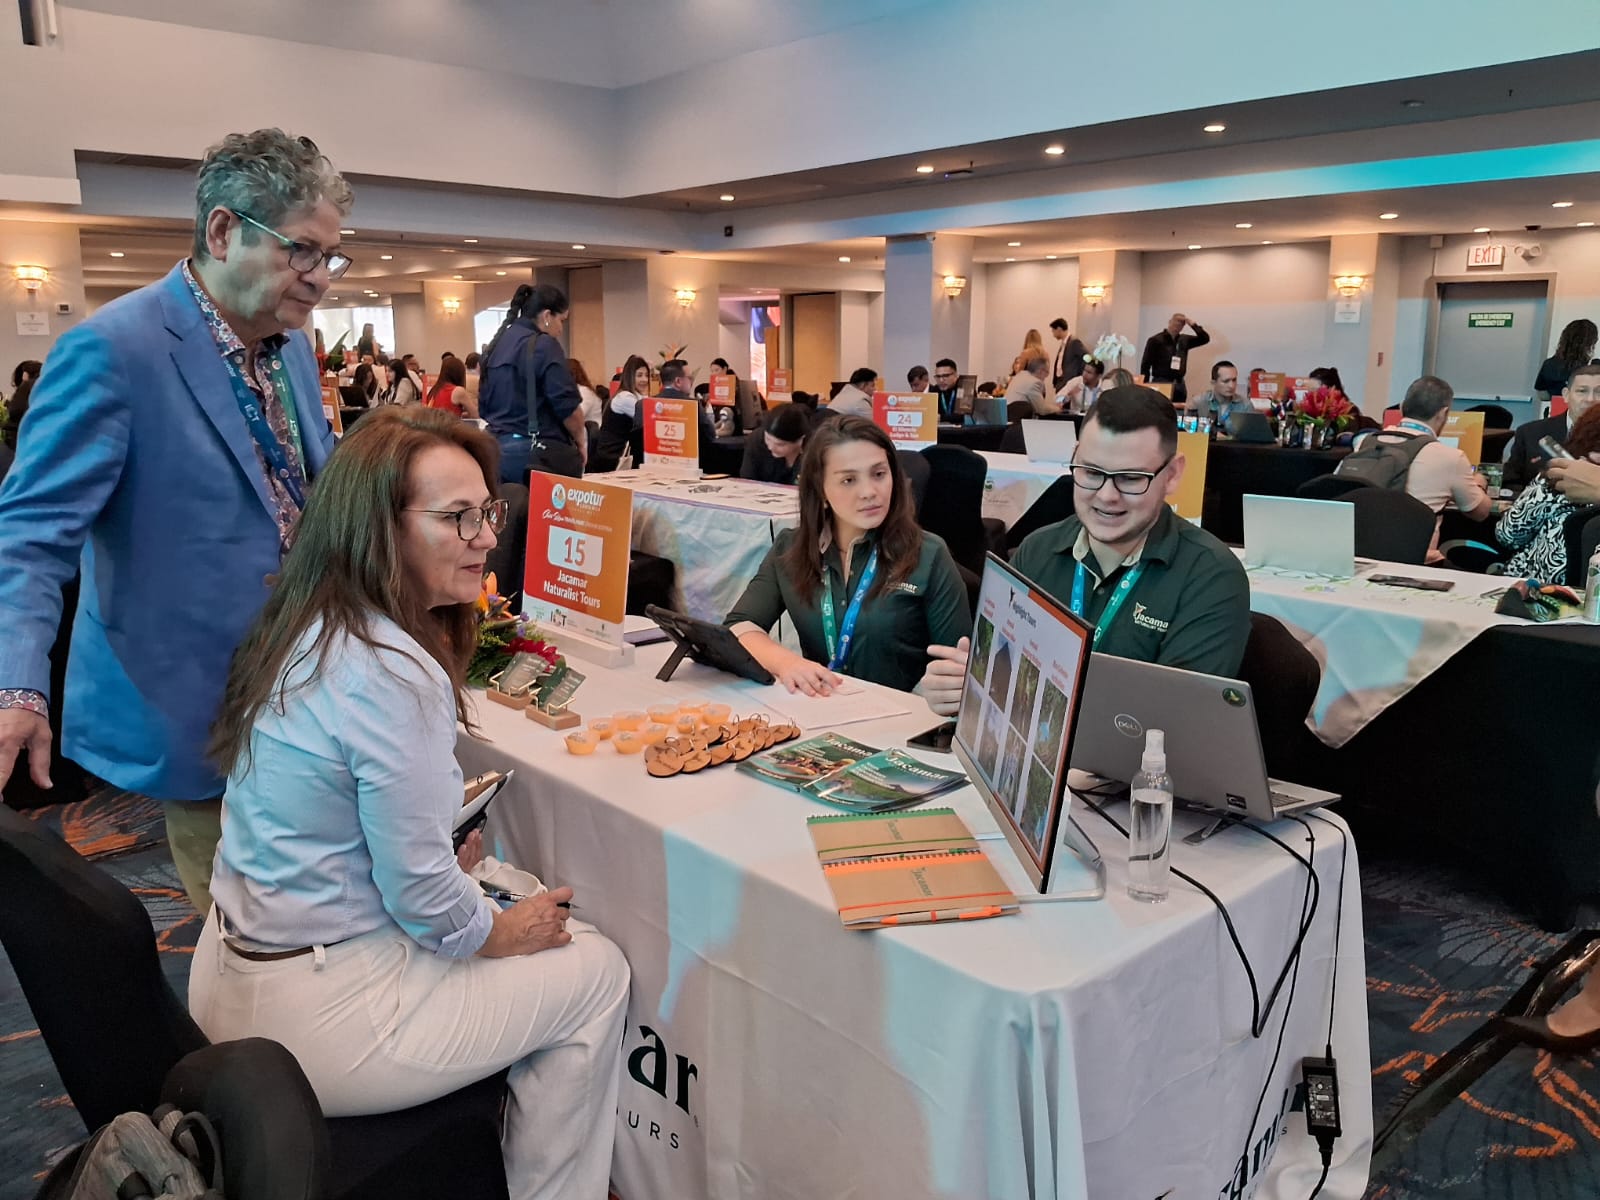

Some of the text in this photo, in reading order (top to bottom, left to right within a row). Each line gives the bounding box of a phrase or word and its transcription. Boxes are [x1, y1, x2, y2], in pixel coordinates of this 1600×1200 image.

[1475, 247, 1497, 263] EXIT
[897, 414, 912, 424] 24
[664, 424, 676, 437] 25
[567, 488, 604, 507] expotur
[564, 536, 586, 567] 15
[557, 570, 588, 589] Jacamar
[543, 580, 601, 609] Naturalist Tours
[1134, 611, 1169, 629] Jacama
[827, 739, 873, 758] Jacama
[886, 757, 949, 779] Jacamar
[621, 1016, 698, 1115] ar
[616, 1107, 680, 1150] URS
